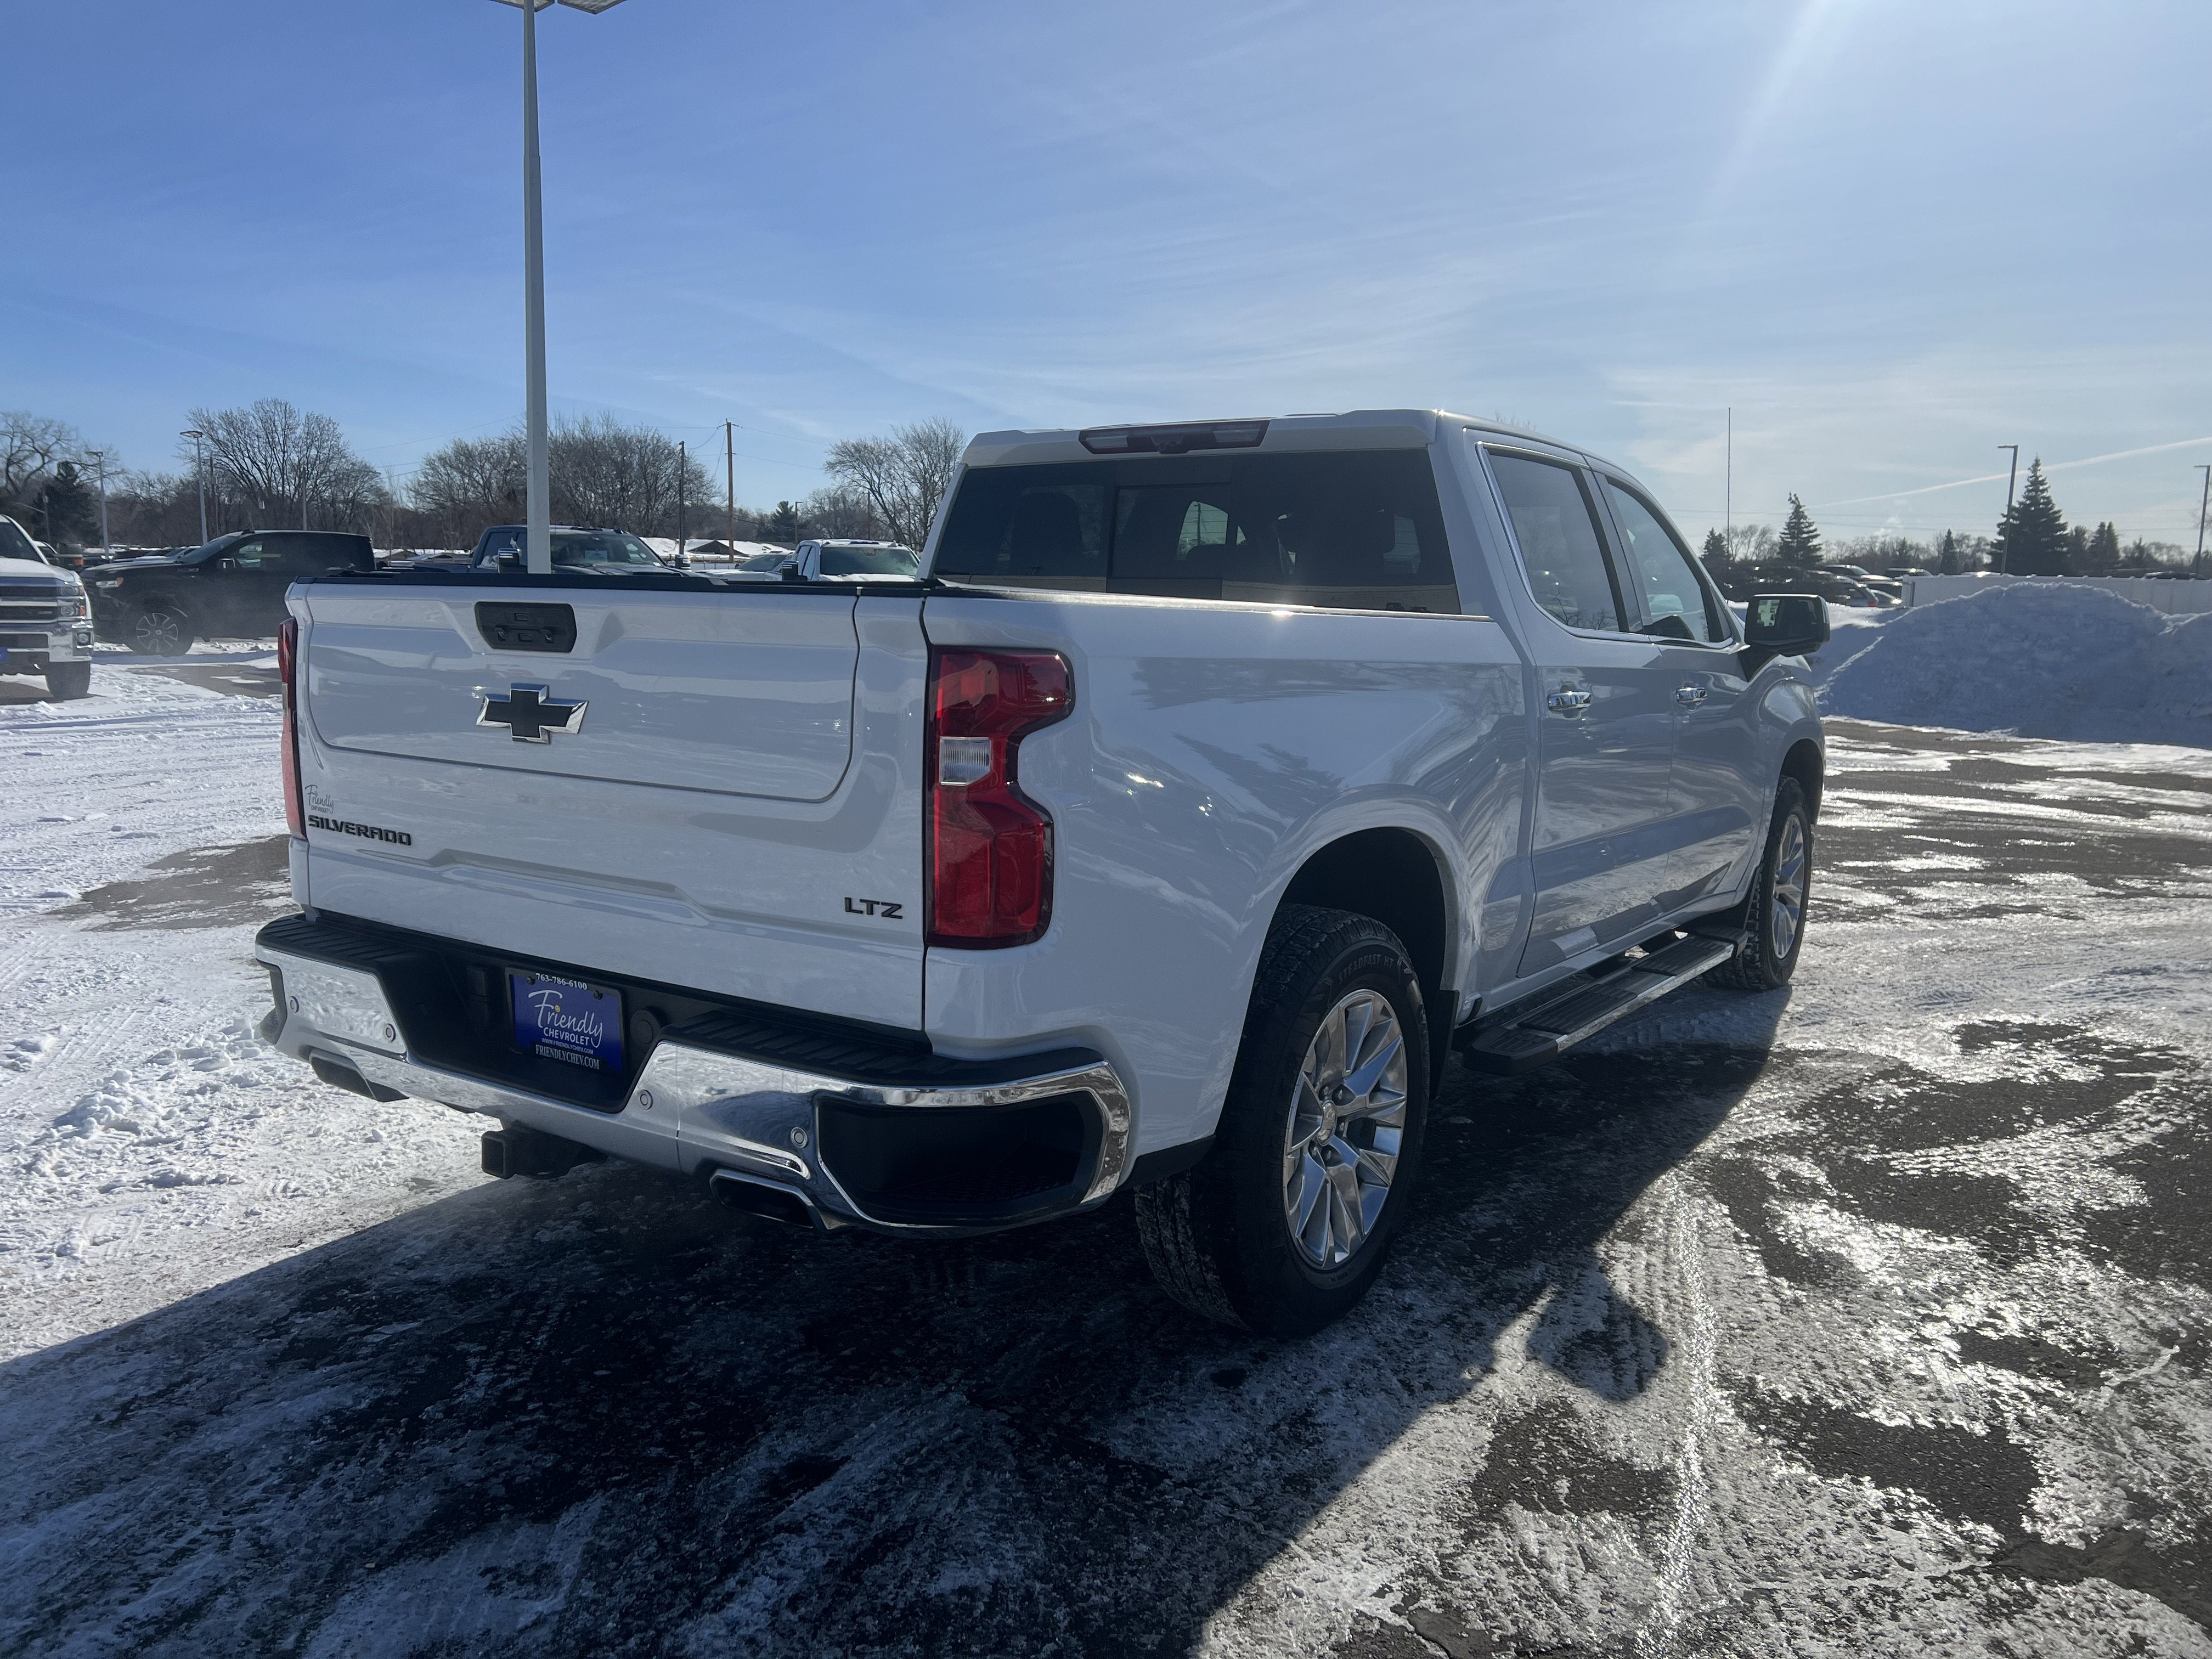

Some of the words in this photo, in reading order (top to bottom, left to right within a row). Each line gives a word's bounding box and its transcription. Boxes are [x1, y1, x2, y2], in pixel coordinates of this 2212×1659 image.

[305, 784, 334, 814] Friendly
[308, 815, 411, 846] SILVERADO
[844, 897, 903, 919] LTZ
[535, 973, 588, 990] 763-786-6100
[1339, 953, 1381, 984] STEADFAST
[528, 990, 603, 1048] Friendly
[541, 1038, 594, 1055] WWW.FRIENDLYCHEV.COM
[543, 1027, 590, 1046] CHEVROLET
[535, 1044, 600, 1070] FRIENDLYCHEV.COM
